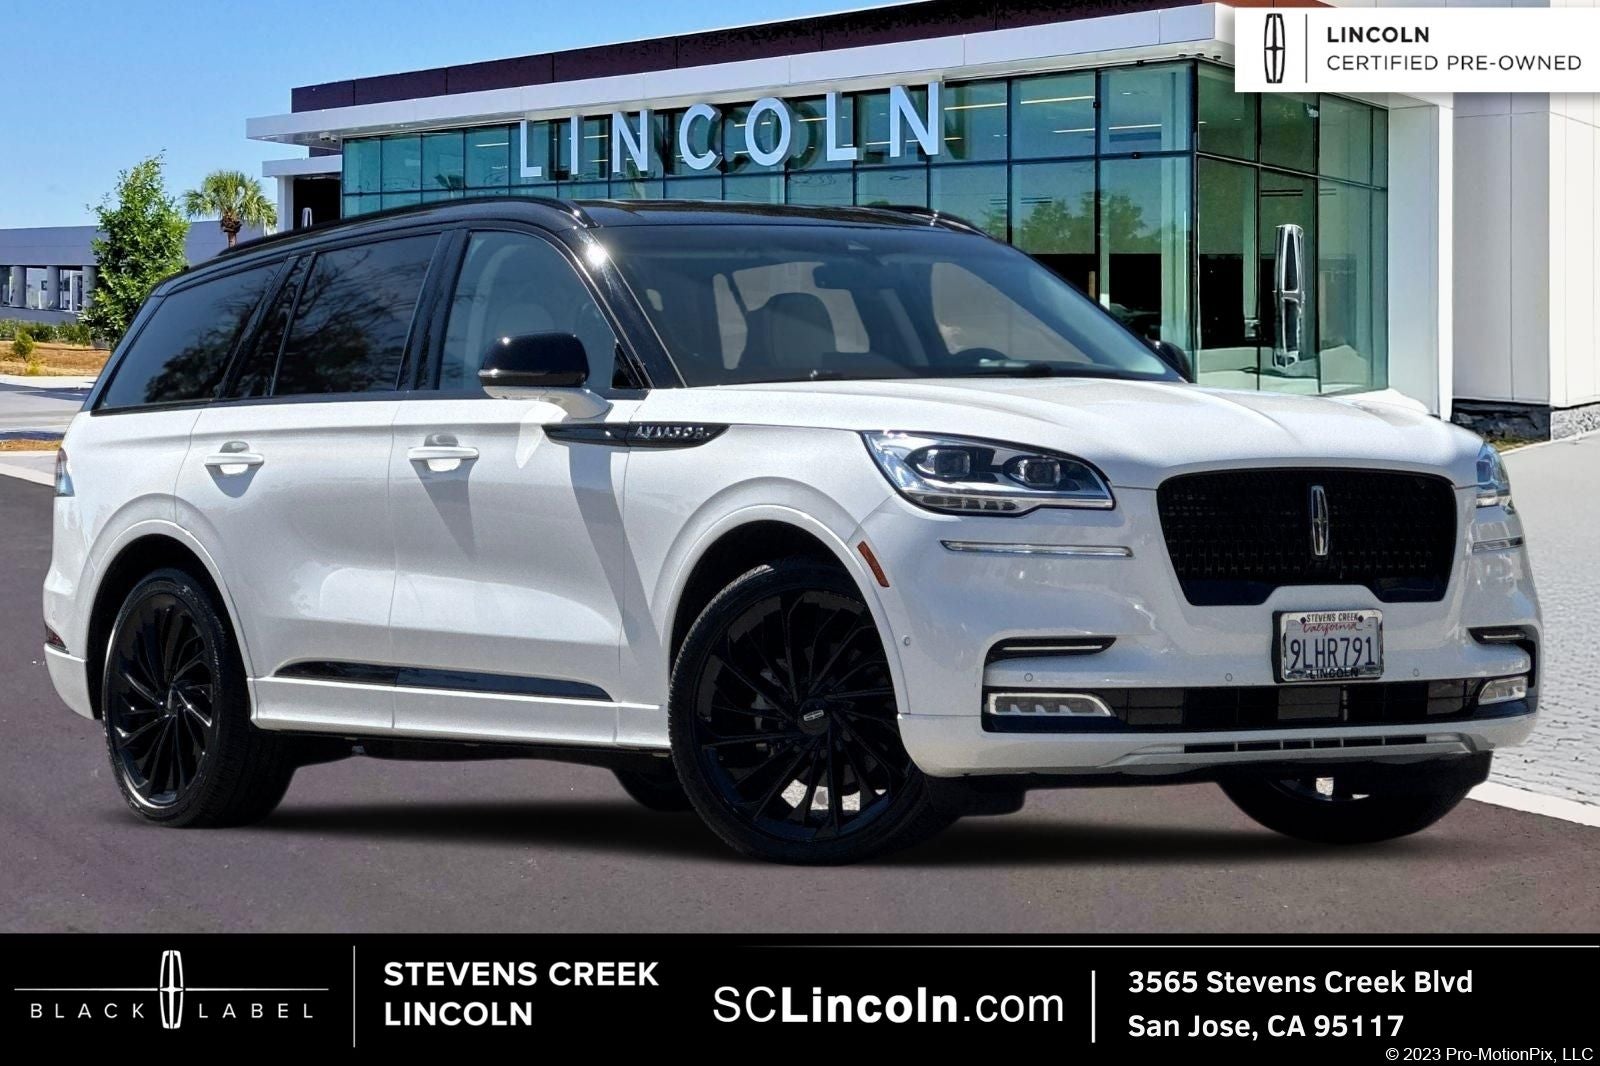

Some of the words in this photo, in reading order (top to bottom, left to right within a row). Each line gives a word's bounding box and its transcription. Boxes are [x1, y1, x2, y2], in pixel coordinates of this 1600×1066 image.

[520, 81, 943, 178] LINCOLN
[1306, 613, 1336, 623] STEVENS
[1338, 612, 1358, 622] CREEK
[1302, 622, 1362, 636] California
[1290, 636, 1376, 669] 9LHR791
[1308, 667, 1359, 679] LINCOLN
